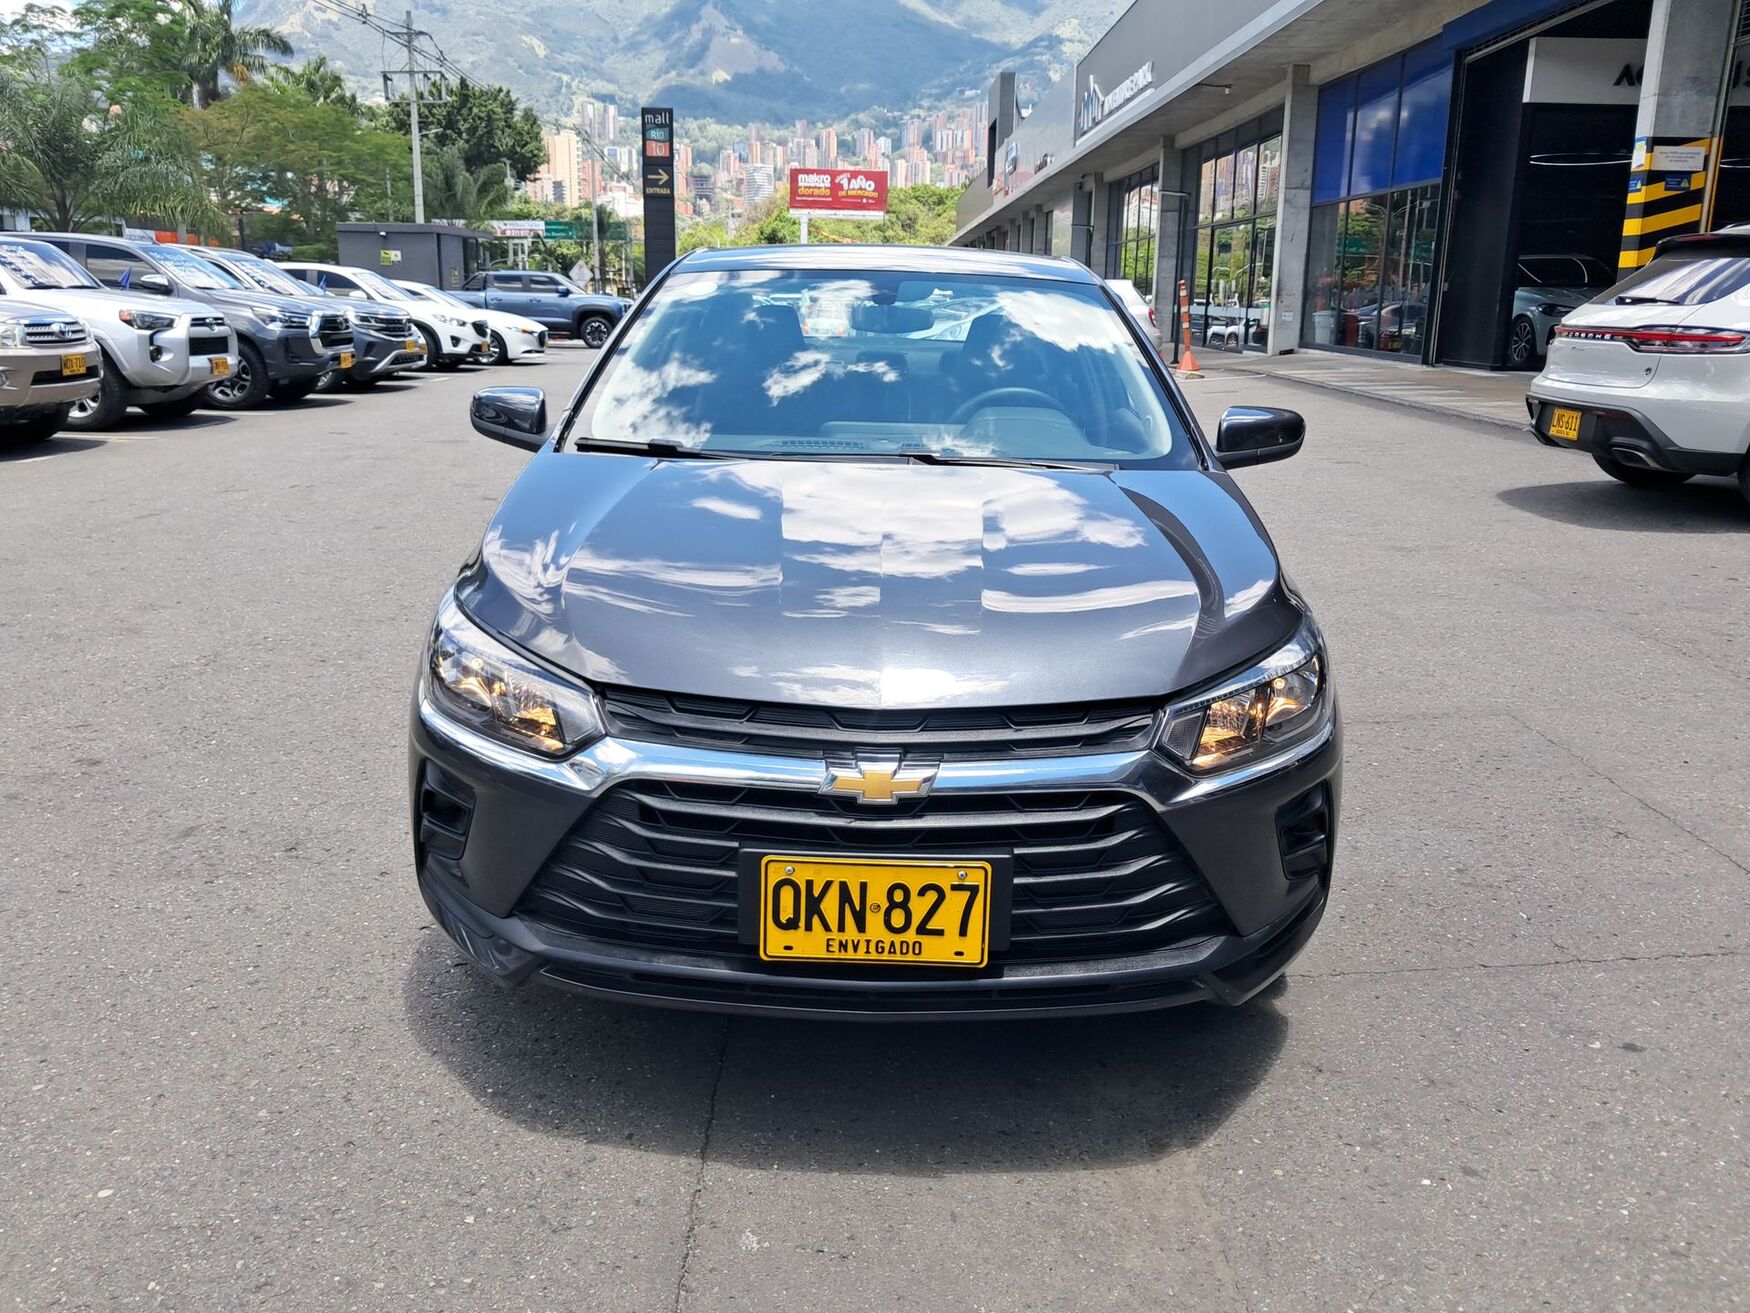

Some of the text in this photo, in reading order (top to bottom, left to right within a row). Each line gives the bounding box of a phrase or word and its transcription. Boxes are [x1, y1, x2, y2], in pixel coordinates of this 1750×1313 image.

[645, 112, 670, 124] mall
[652, 142, 665, 156] 10
[798, 173, 831, 184] makro
[850, 175, 875, 191] AÑO
[798, 187, 831, 196] dorado
[848, 190, 879, 198] MERCADO
[826, 938, 922, 956] ENVIGADO
